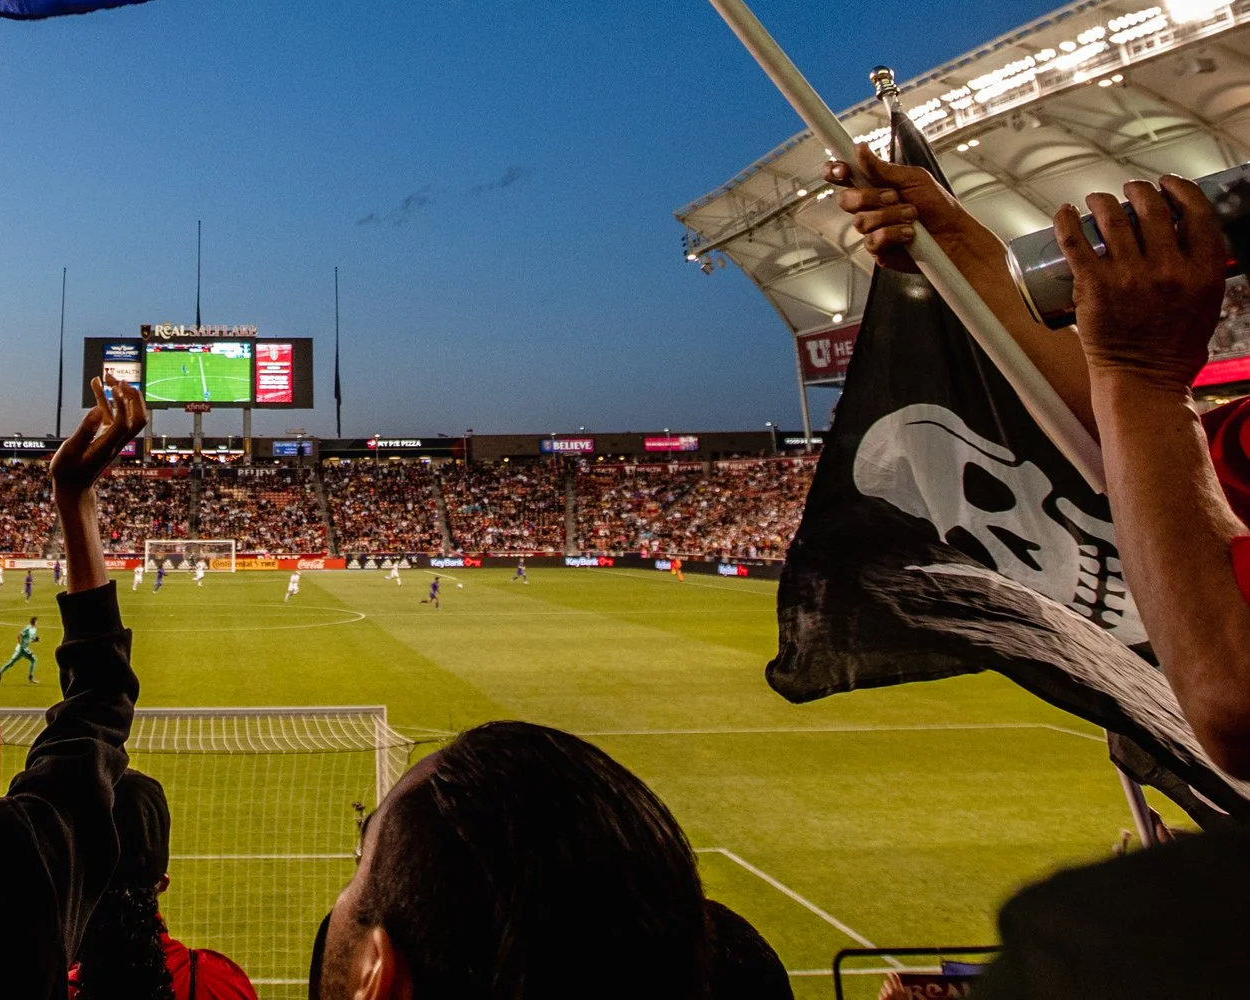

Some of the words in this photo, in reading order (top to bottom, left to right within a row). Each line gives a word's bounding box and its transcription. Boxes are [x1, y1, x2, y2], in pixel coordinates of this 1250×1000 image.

[190, 324, 220, 337] SALT
[222, 324, 258, 337] LAKE
[553, 441, 592, 450] BELIEVE
[212, 560, 252, 568] Contiental
[430, 558, 464, 568] KeyBank
[565, 557, 599, 567] KeyBank
